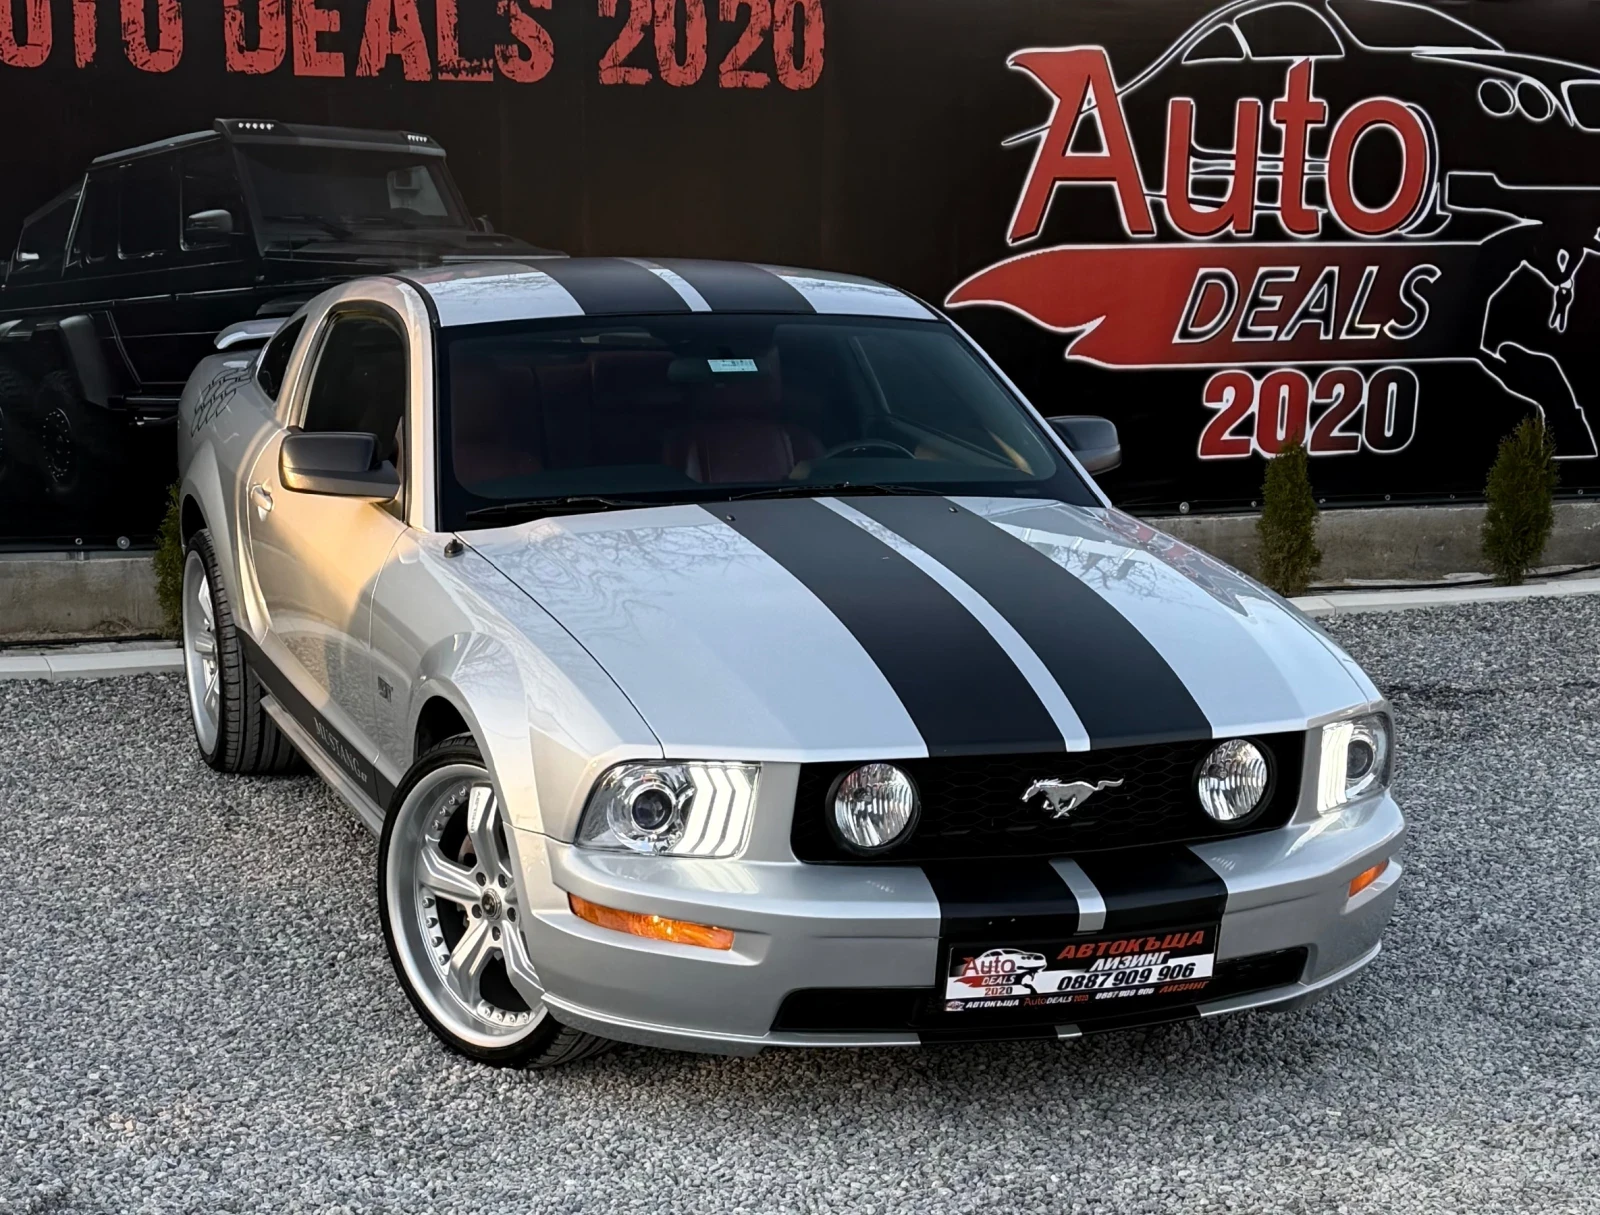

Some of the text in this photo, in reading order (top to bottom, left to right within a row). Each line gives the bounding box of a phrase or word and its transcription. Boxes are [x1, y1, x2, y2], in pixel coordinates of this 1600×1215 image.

[223, 0, 554, 83] DEALS
[598, 0, 825, 90] 2020
[1005, 44, 1440, 246] Auto
[1171, 264, 1442, 344] DEALS
[1197, 366, 1420, 459] 2020
[1056, 930, 1205, 960] АВТОКЪЩА
[962, 956, 1017, 976] Auto
[1089, 951, 1170, 972] ЛИЗИНГ
[1157, 962, 1196, 981] 906
[981, 975, 1016, 986] DEALS
[984, 986, 1013, 997] 2020
